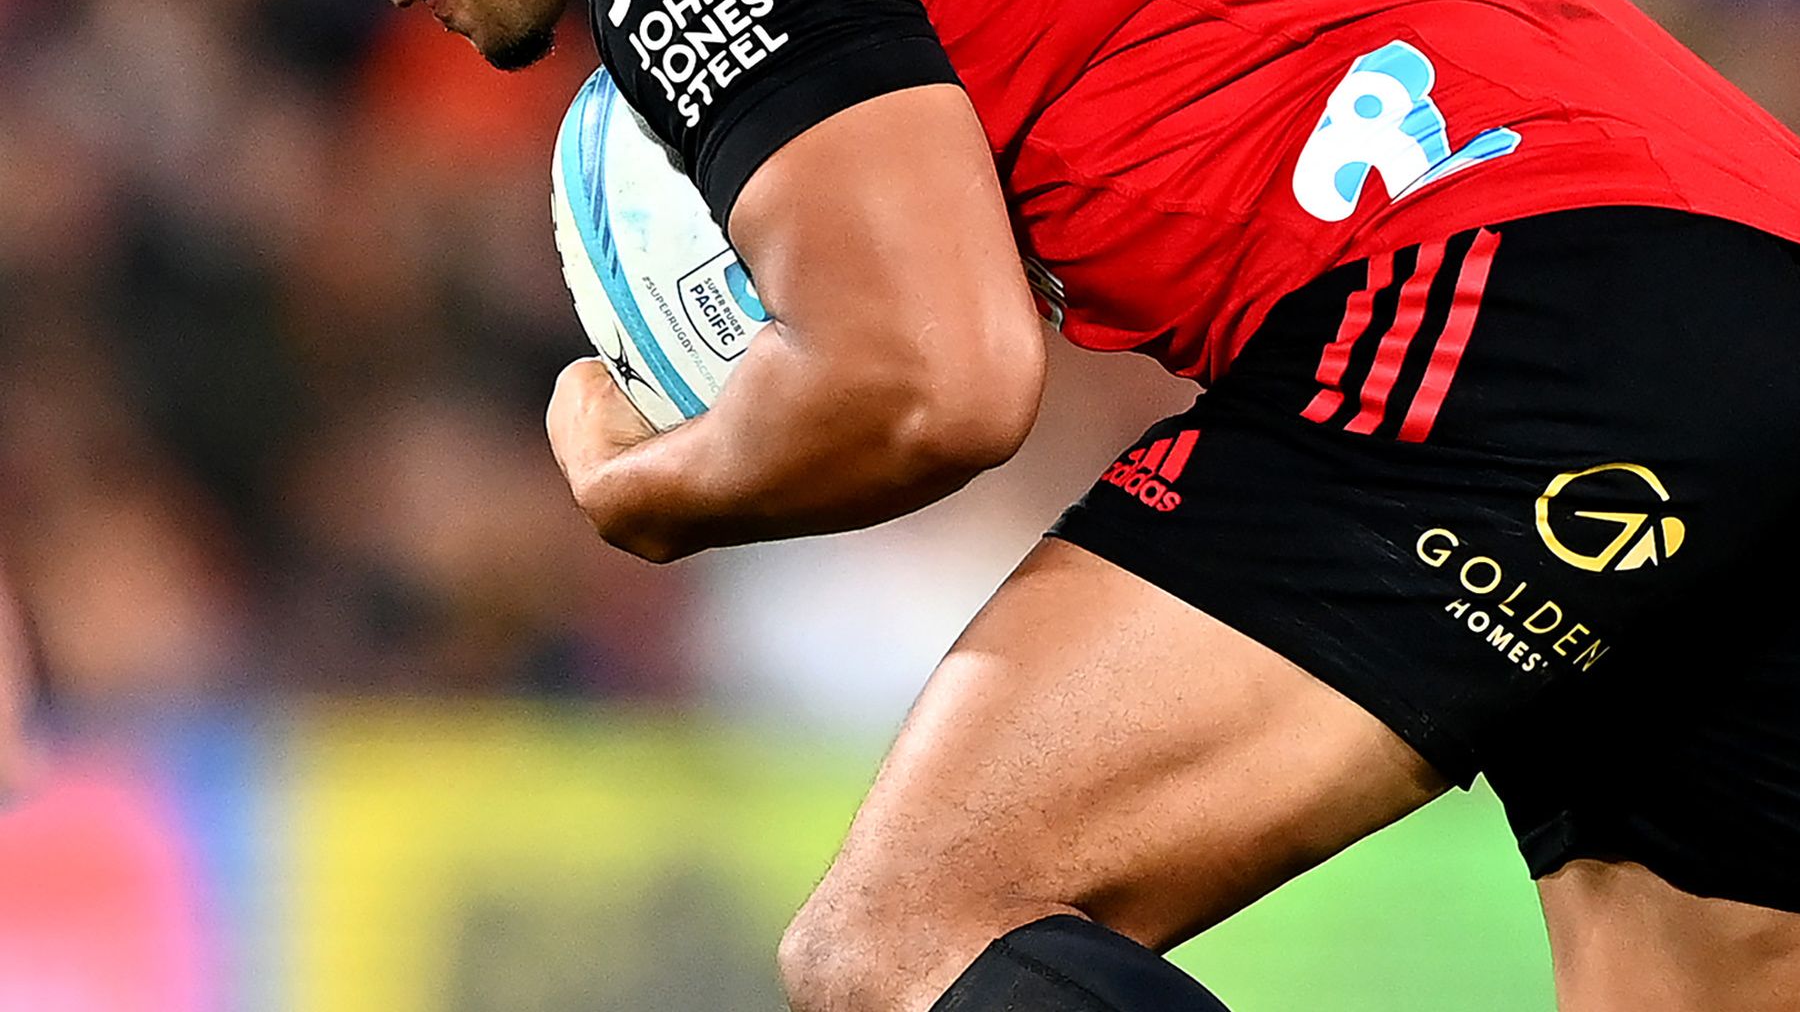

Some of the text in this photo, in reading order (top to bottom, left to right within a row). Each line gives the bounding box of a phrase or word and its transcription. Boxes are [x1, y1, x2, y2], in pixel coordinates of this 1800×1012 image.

[677, 24, 789, 128] STEEL
[689, 283, 736, 346] PACIFIC
[703, 277, 747, 337] SUPER RUGBY
[1416, 528, 1611, 672] GOLDEN
